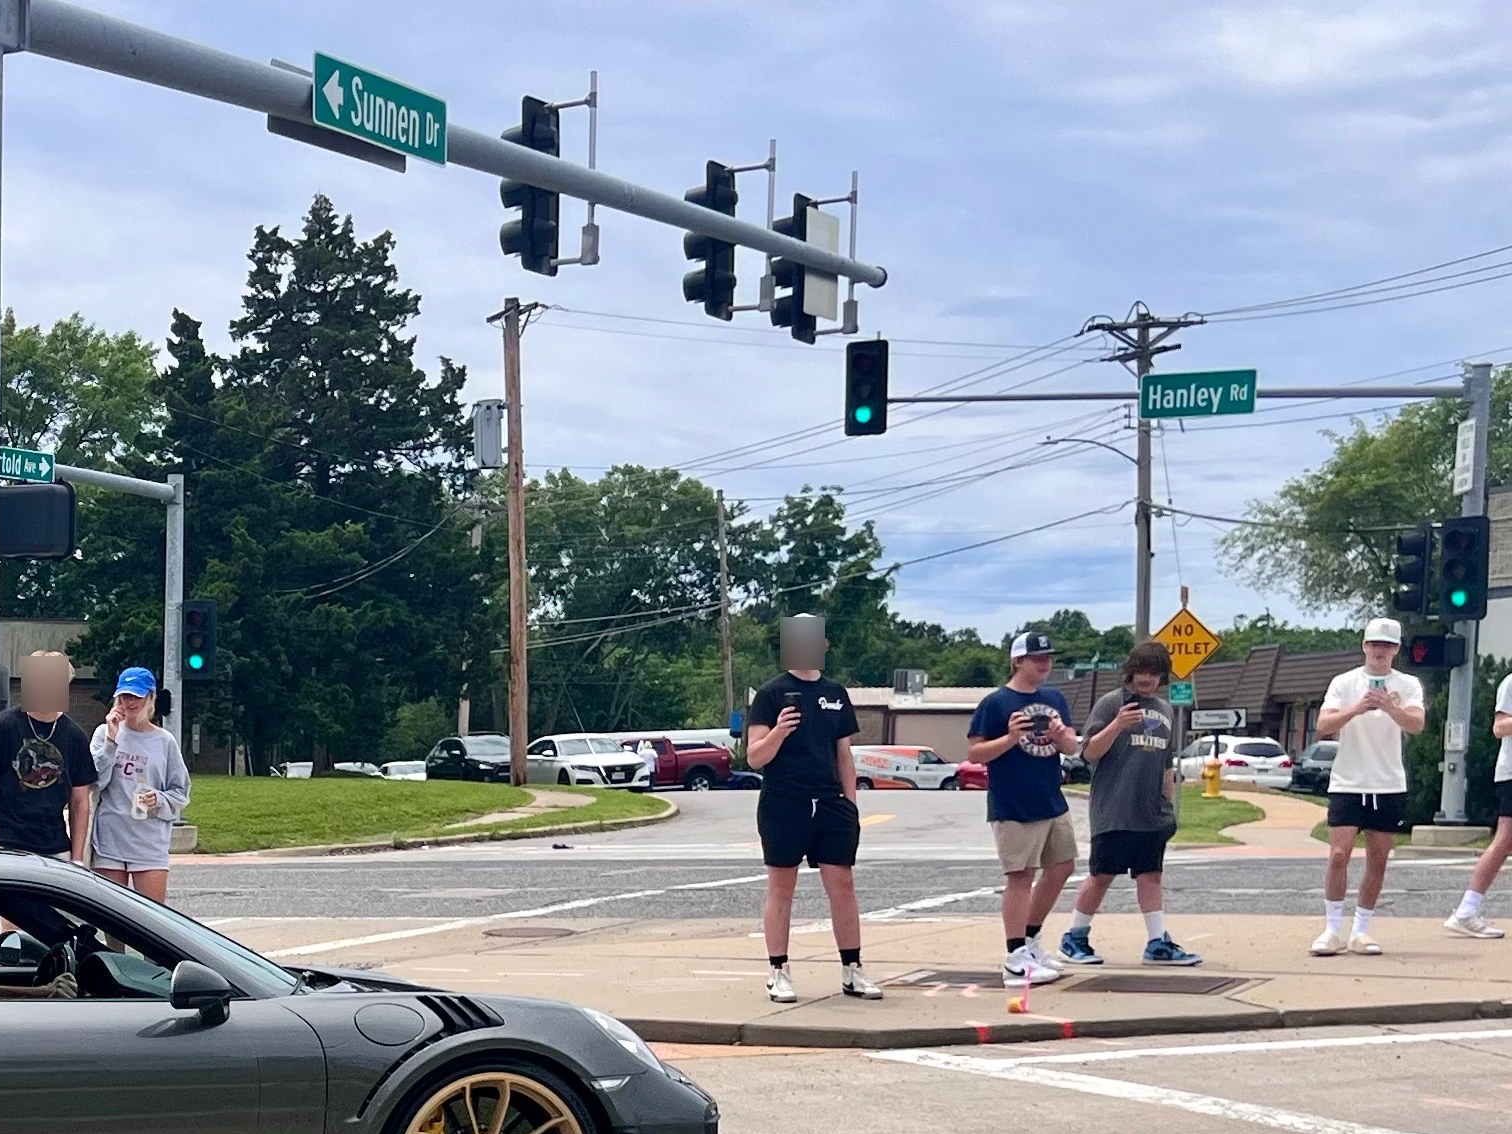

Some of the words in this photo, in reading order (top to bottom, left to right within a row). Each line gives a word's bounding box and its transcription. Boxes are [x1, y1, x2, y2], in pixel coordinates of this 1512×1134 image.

[350, 75, 420, 149] Sunnen
[425, 111, 440, 148] Dr
[1148, 382, 1223, 413] Hanley
[1229, 383, 1249, 401] Rd
[0, 451, 22, 475] told
[1172, 623, 1194, 637] NO
[1169, 641, 1211, 655] UTLET
